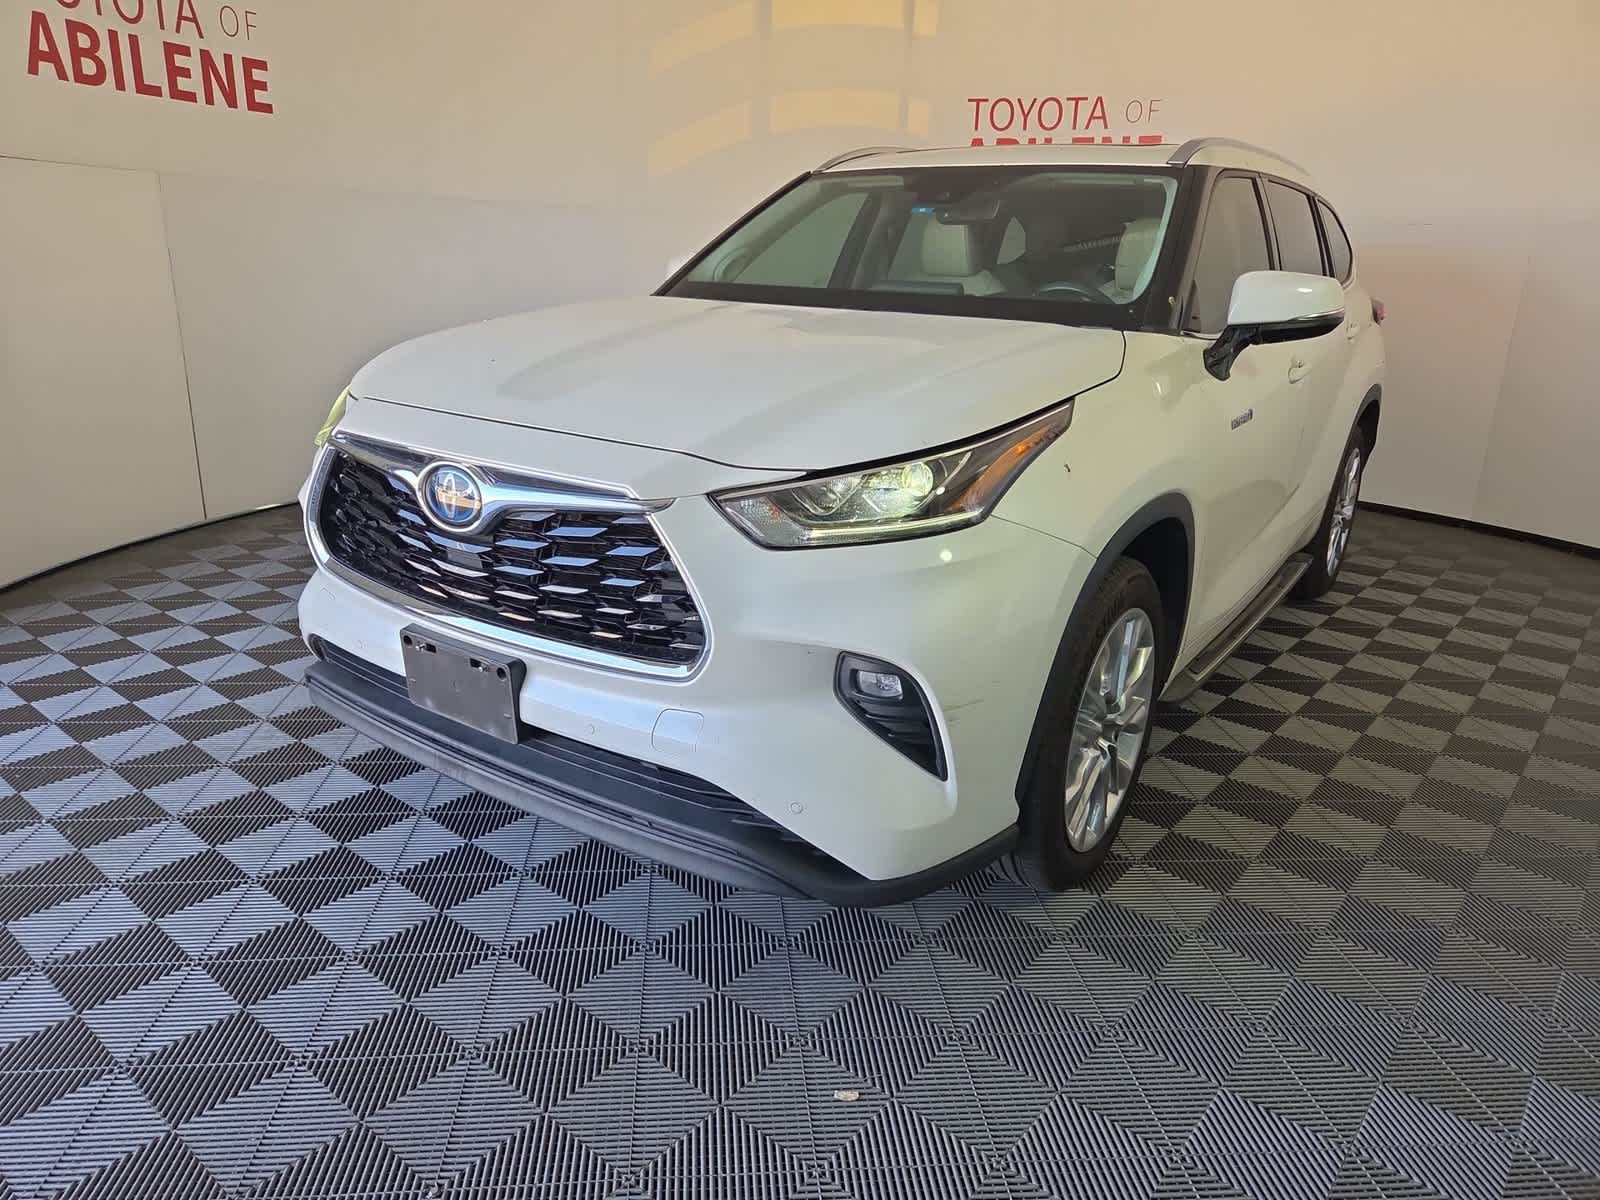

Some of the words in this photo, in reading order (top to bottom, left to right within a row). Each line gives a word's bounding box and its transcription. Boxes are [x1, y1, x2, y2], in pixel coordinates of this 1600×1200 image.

[220, 5, 257, 40] OF
[27, 10, 274, 114] ABILENE
[967, 96, 1109, 132] TOYOTA
[1125, 99, 1162, 124] OF
